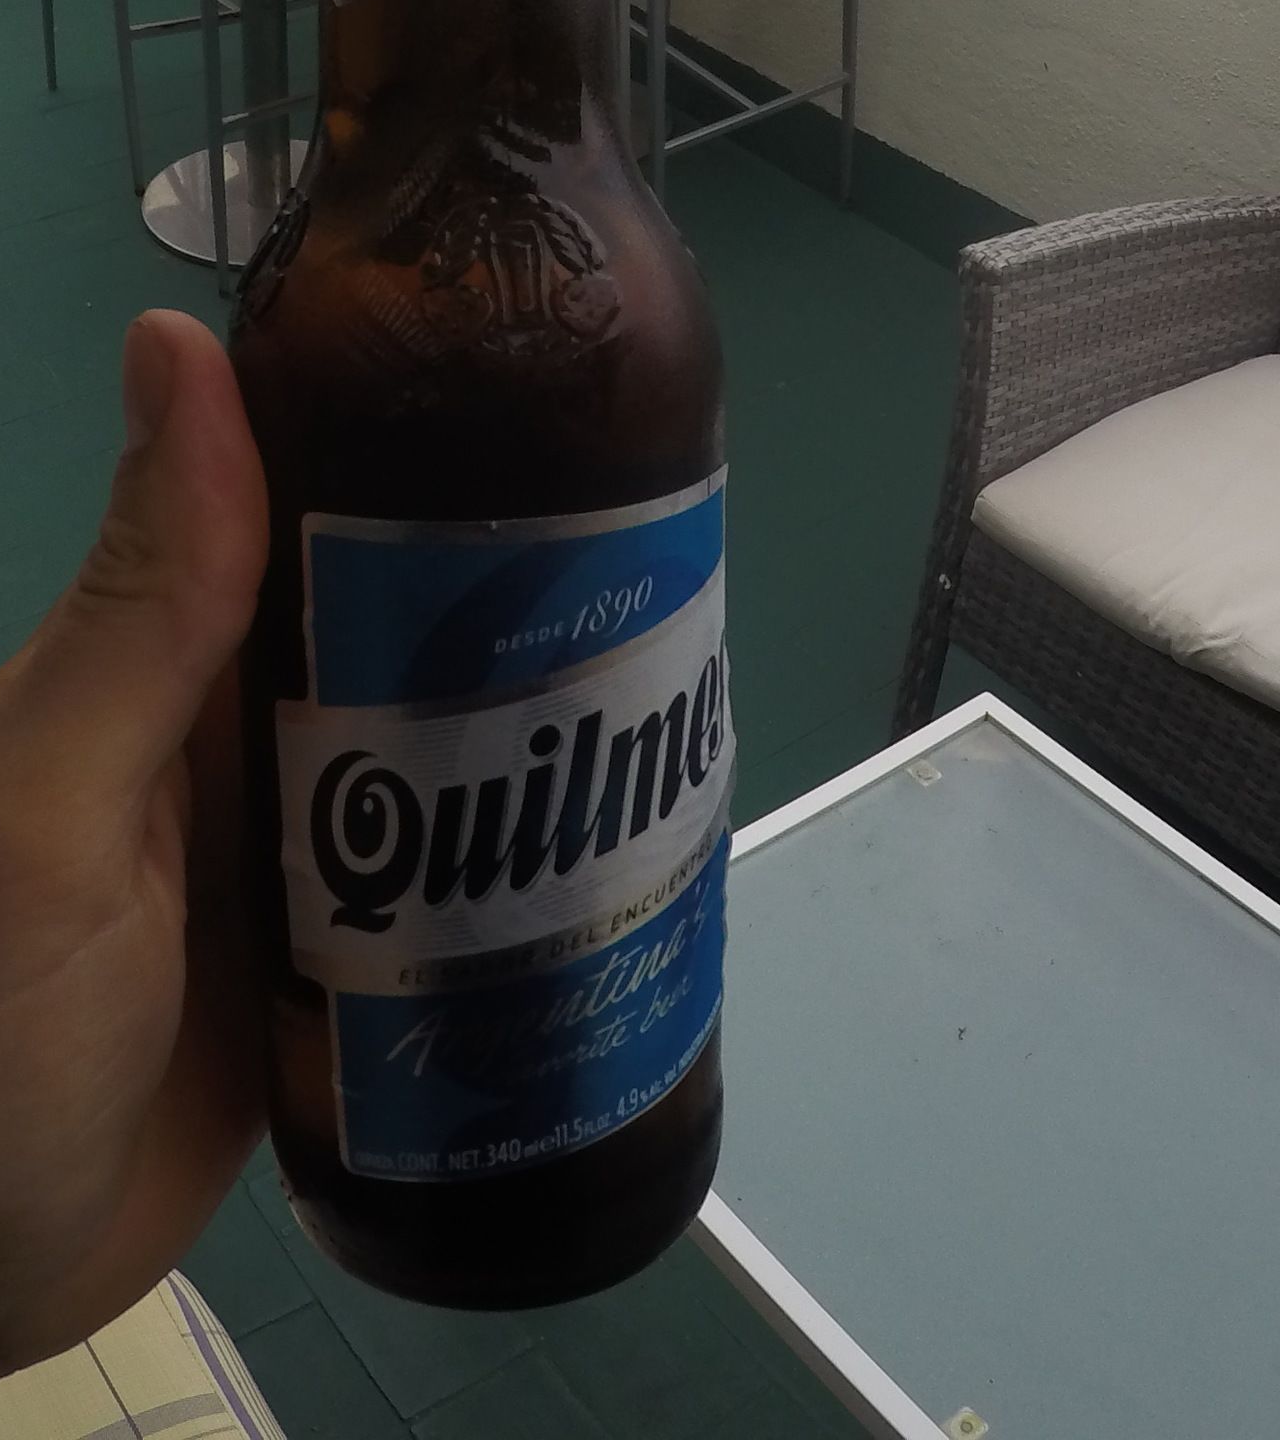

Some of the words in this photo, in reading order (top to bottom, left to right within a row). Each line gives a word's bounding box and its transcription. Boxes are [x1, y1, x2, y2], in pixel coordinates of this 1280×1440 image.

[494, 620, 566, 655] DESDE
[571, 575, 654, 642] 1890
[398, 968, 425, 986] EL
[550, 927, 596, 959] DEL
[610, 836, 715, 935] ENCUENTRO
[487, 1138, 522, 1167] 340
